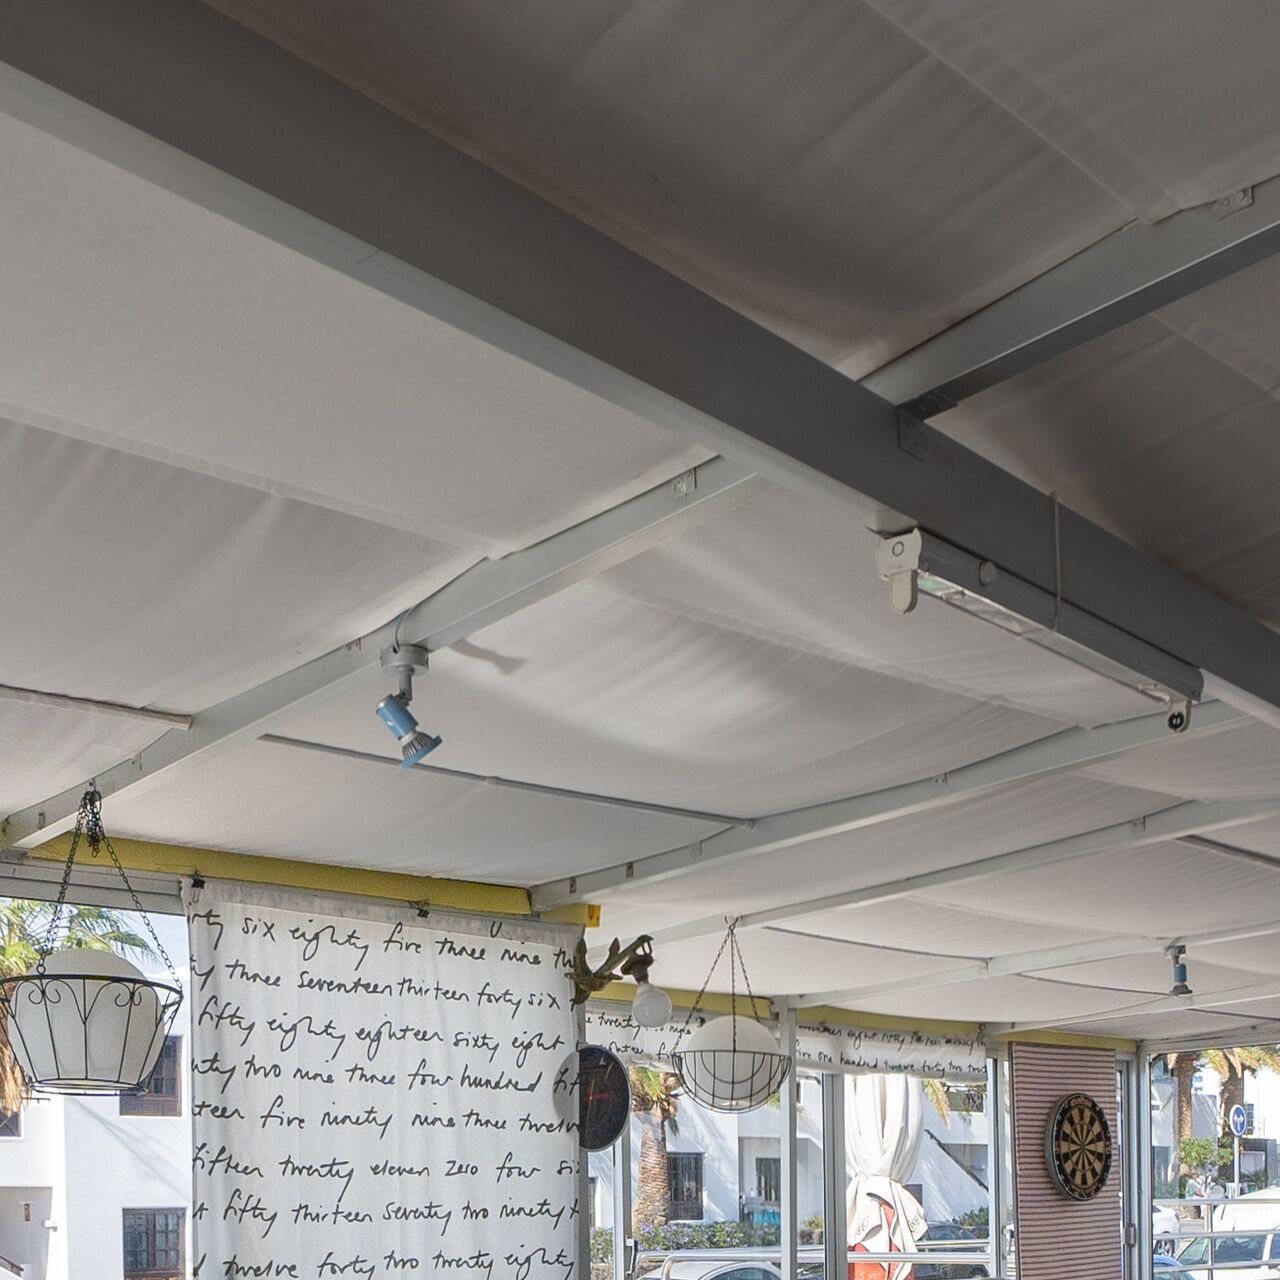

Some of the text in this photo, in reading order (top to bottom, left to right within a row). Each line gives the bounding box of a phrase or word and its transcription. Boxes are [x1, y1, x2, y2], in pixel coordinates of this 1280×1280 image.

[242, 917, 275, 942] six
[288, 919, 369, 971] eighty
[383, 921, 421, 953] five
[435, 938, 485, 960] three
[501, 942, 541, 965] nine
[225, 959, 281, 987] three
[397, 977, 469, 1002] thirteen
[477, 982, 522, 1019] forty
[528, 993, 560, 1010] six
[198, 994, 566, 1068] fifty eighty eighteen sixty eight
[245, 1055, 281, 1078] two
[293, 1060, 335, 1083] nine
[345, 1063, 395, 1085] three
[408, 1058, 453, 1090] four
[460, 1062, 542, 1092] hundred
[260, 1095, 305, 1129] five
[321, 1103, 394, 1142] ninety
[412, 1102, 456, 1127] nine
[462, 1109, 506, 1129] three
[192, 1141, 264, 1179] fifteen
[278, 1155, 355, 1203] twenty
[370, 1160, 430, 1176] eleven
[445, 1160, 478, 1176] zero
[496, 1152, 541, 1183] four
[223, 1188, 277, 1239] fifty
[291, 1199, 373, 1225] thirteen
[383, 1201, 451, 1236] seventy
[462, 1200, 489, 1220] two
[500, 1197, 565, 1230] ninety
[222, 1254, 299, 1280] twelve
[384, 1250, 419, 1270] two
